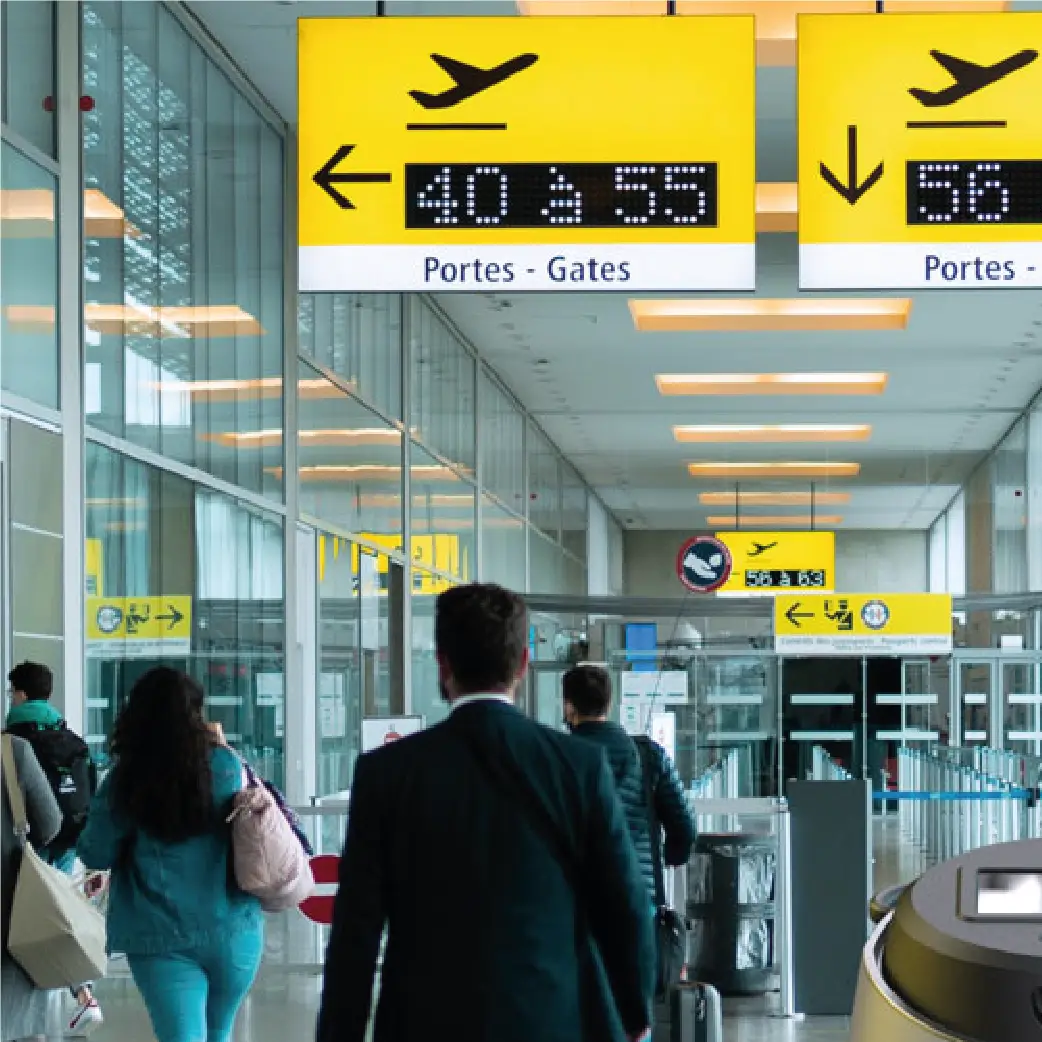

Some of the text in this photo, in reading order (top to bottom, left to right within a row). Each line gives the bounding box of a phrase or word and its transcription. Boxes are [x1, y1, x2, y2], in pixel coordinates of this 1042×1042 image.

[419, 166, 706, 224] 40 à 55
[919, 164, 1009, 222] 56
[425, 257, 515, 283] Portes
[546, 256, 631, 283] Gates
[925, 255, 1016, 281] Portes
[747, 571, 772, 586] 56
[798, 571, 823, 586] 63
